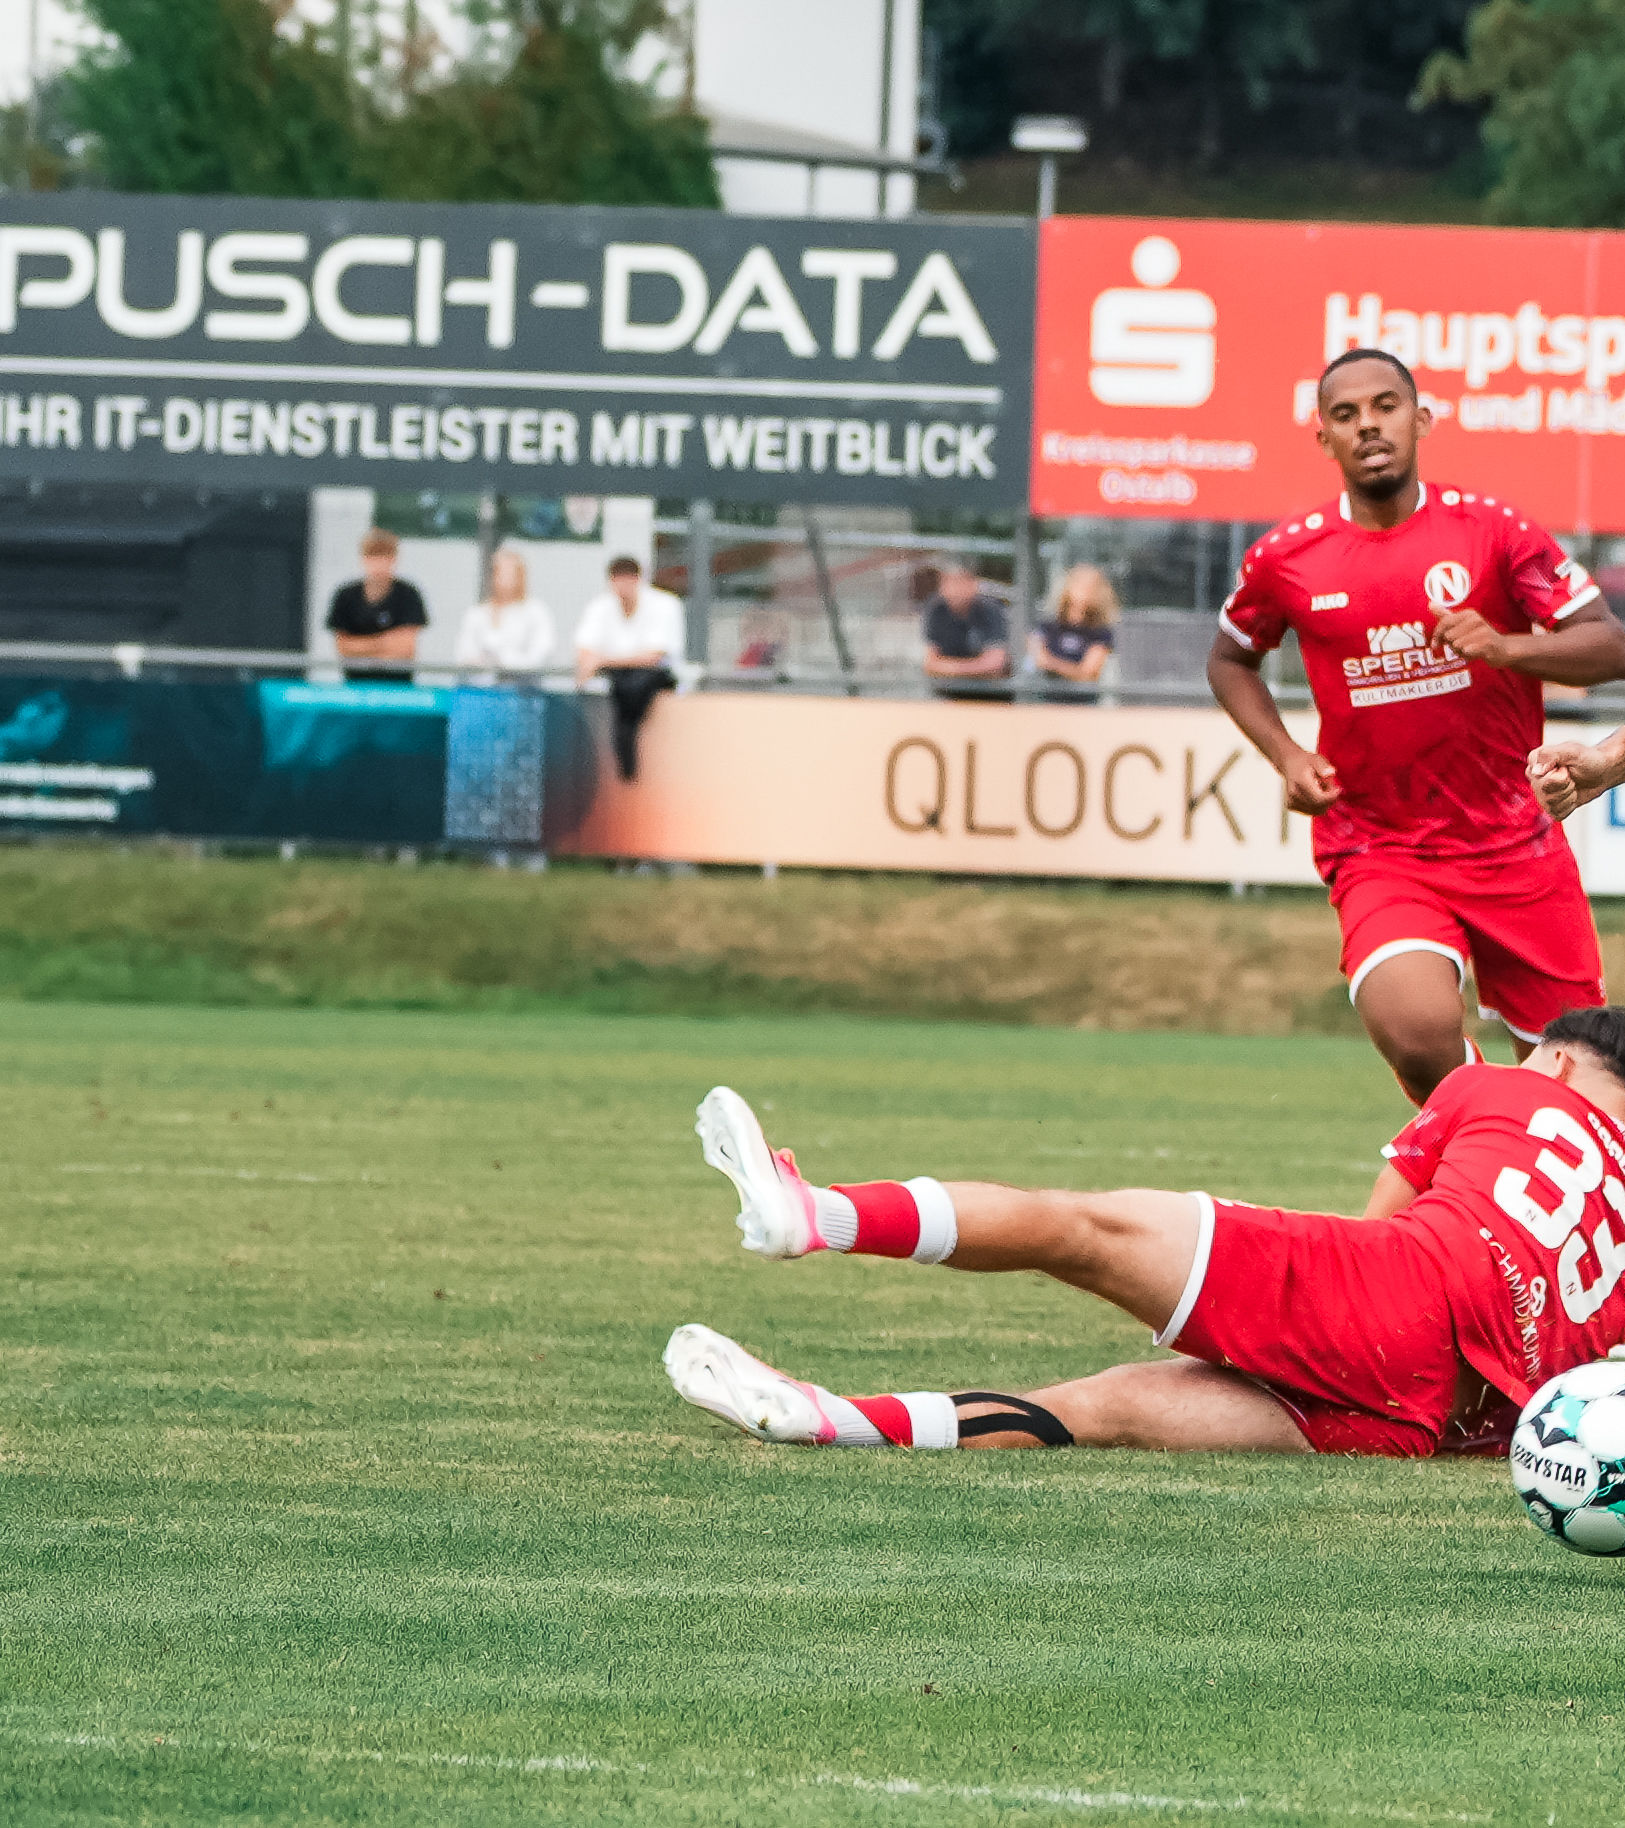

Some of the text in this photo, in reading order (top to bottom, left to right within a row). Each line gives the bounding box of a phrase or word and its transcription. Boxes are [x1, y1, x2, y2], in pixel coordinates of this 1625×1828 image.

[0, 225, 998, 363] PUSCH-DATA
[93, 394, 579, 466] IT-DIENSTLEISTER
[591, 409, 693, 468] MIT
[702, 413, 997, 480] WEITBLICK
[1459, 387, 1542, 432] und
